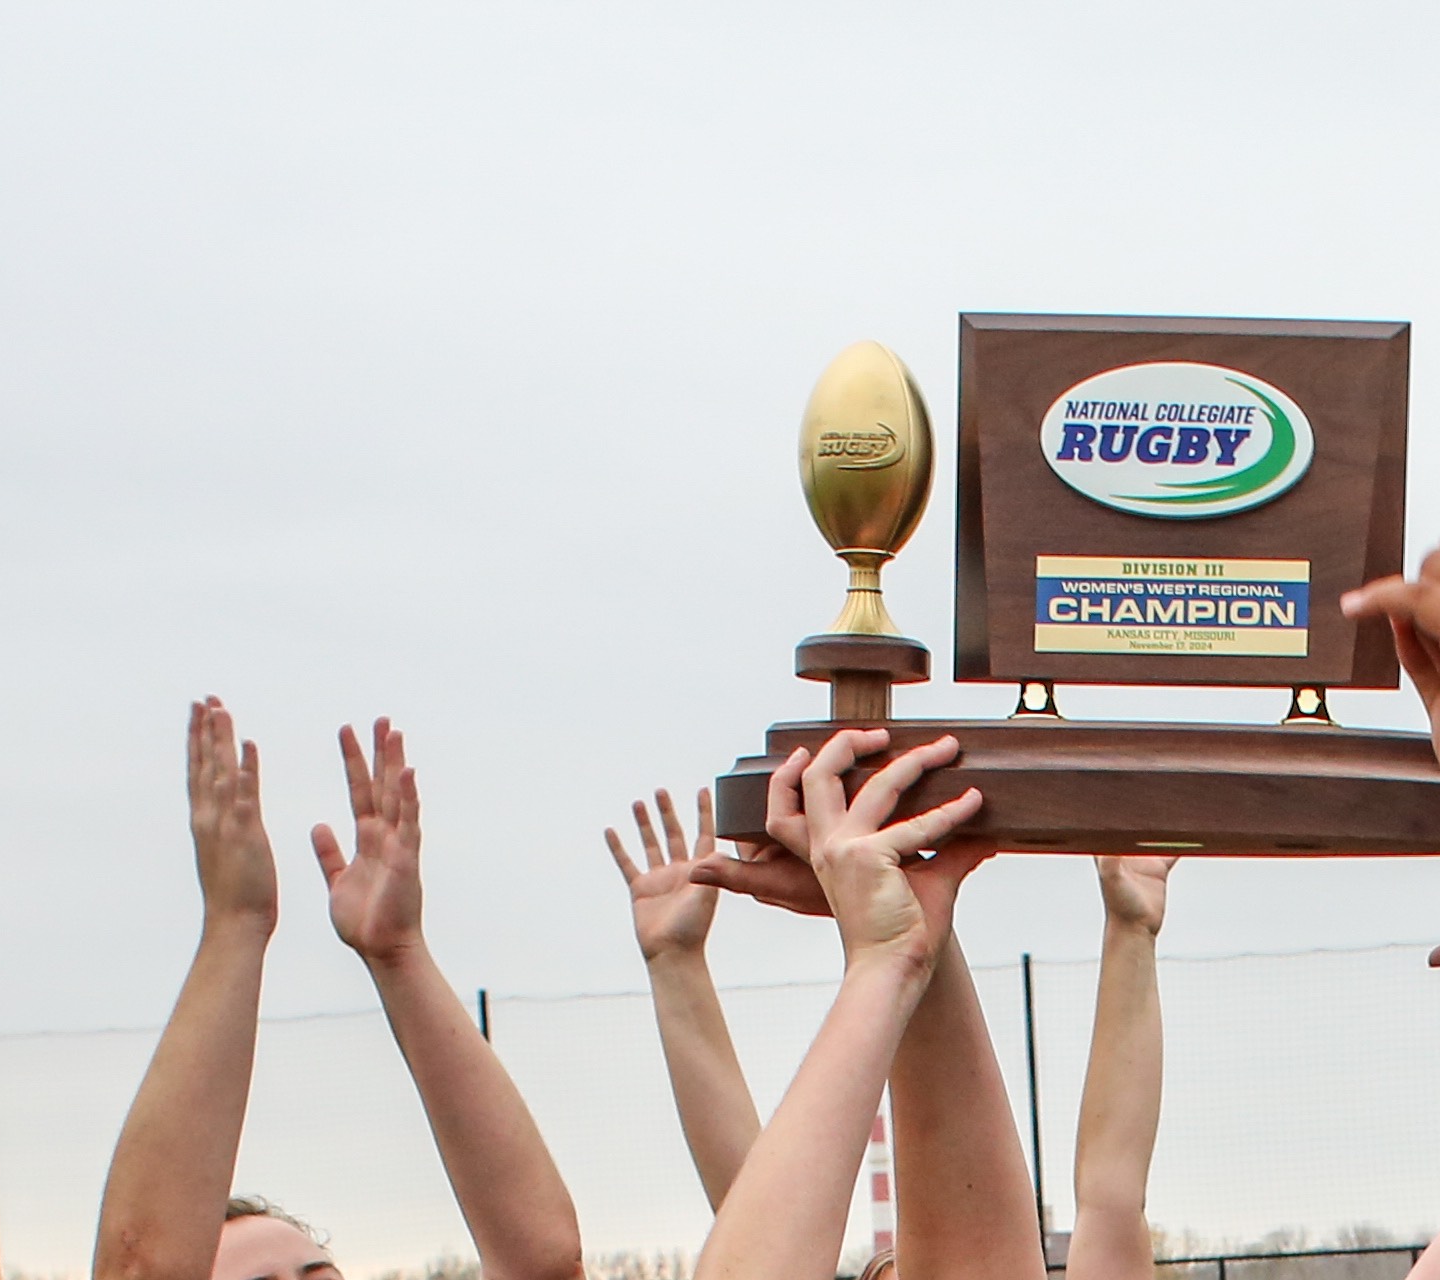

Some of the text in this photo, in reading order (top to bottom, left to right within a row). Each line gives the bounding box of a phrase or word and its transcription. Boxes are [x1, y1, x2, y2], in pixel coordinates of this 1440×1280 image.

[1065, 401, 1256, 424] NATIONAL COLLEGIATE
[1056, 423, 1251, 466] RUGBY
[1122, 562, 1225, 577] DIVISION III
[1061, 581, 1284, 598] WOMEN'S WEST REGIONAL
[1048, 597, 1296, 626] CHAMPION
[1107, 629, 1151, 640] KANSAS
[1184, 631, 1236, 642] MISSOURI
[1129, 640, 1173, 650] November
[1189, 642, 1213, 651] 2024
